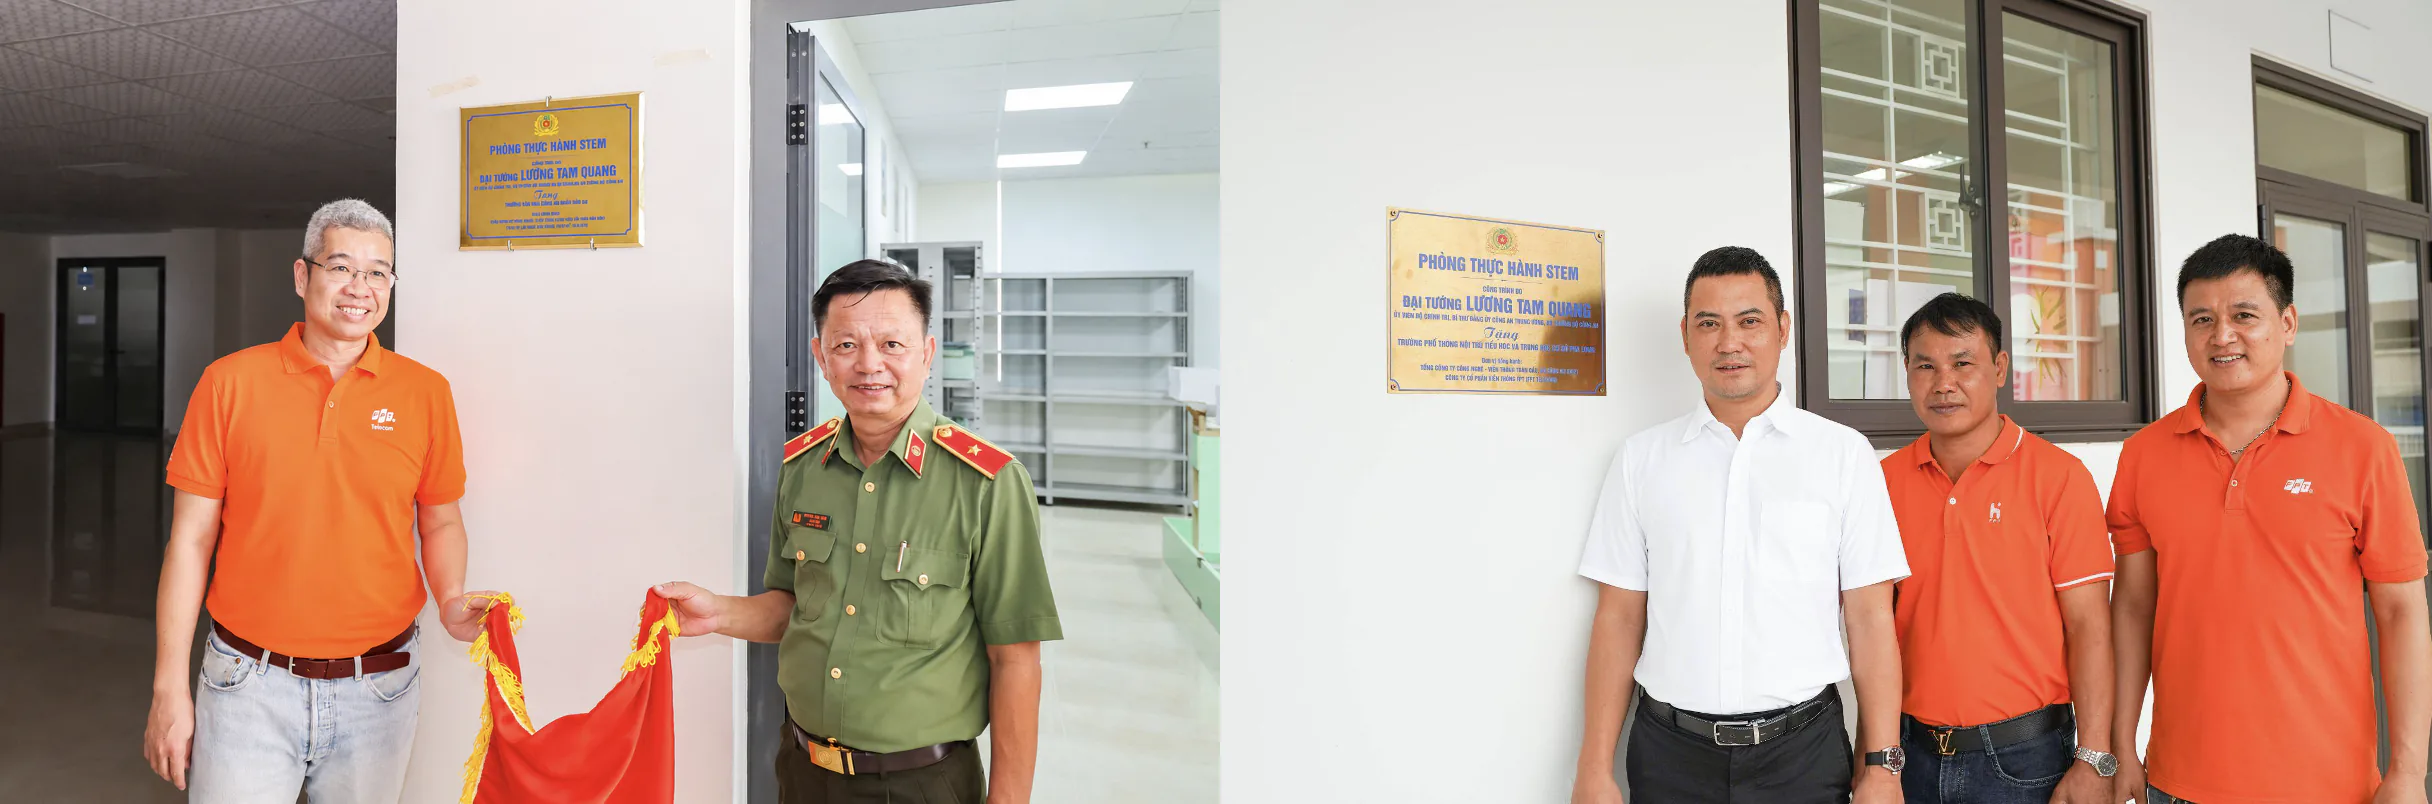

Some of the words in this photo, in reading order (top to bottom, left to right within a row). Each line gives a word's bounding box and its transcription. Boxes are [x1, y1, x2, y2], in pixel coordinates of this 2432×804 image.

[489, 142, 521, 156] PHÒNG
[523, 141, 548, 156] THỰC
[550, 138, 577, 152] HÀNH
[579, 137, 607, 150] STEM
[556, 166, 579, 180] TAM
[581, 164, 617, 179] QUANG
[1418, 251, 1466, 272] PHÒNG
[1469, 257, 1504, 277] THỰC
[1507, 258, 1543, 278] HÀNH
[1545, 264, 1579, 281] STEM
[1402, 295, 1422, 311] ĐẠI
[1425, 295, 1462, 311] TƯỚNG
[1466, 295, 1513, 314] LƯƠNG
[1516, 298, 1544, 316] TAM
[1548, 300, 1592, 319] QUANG
